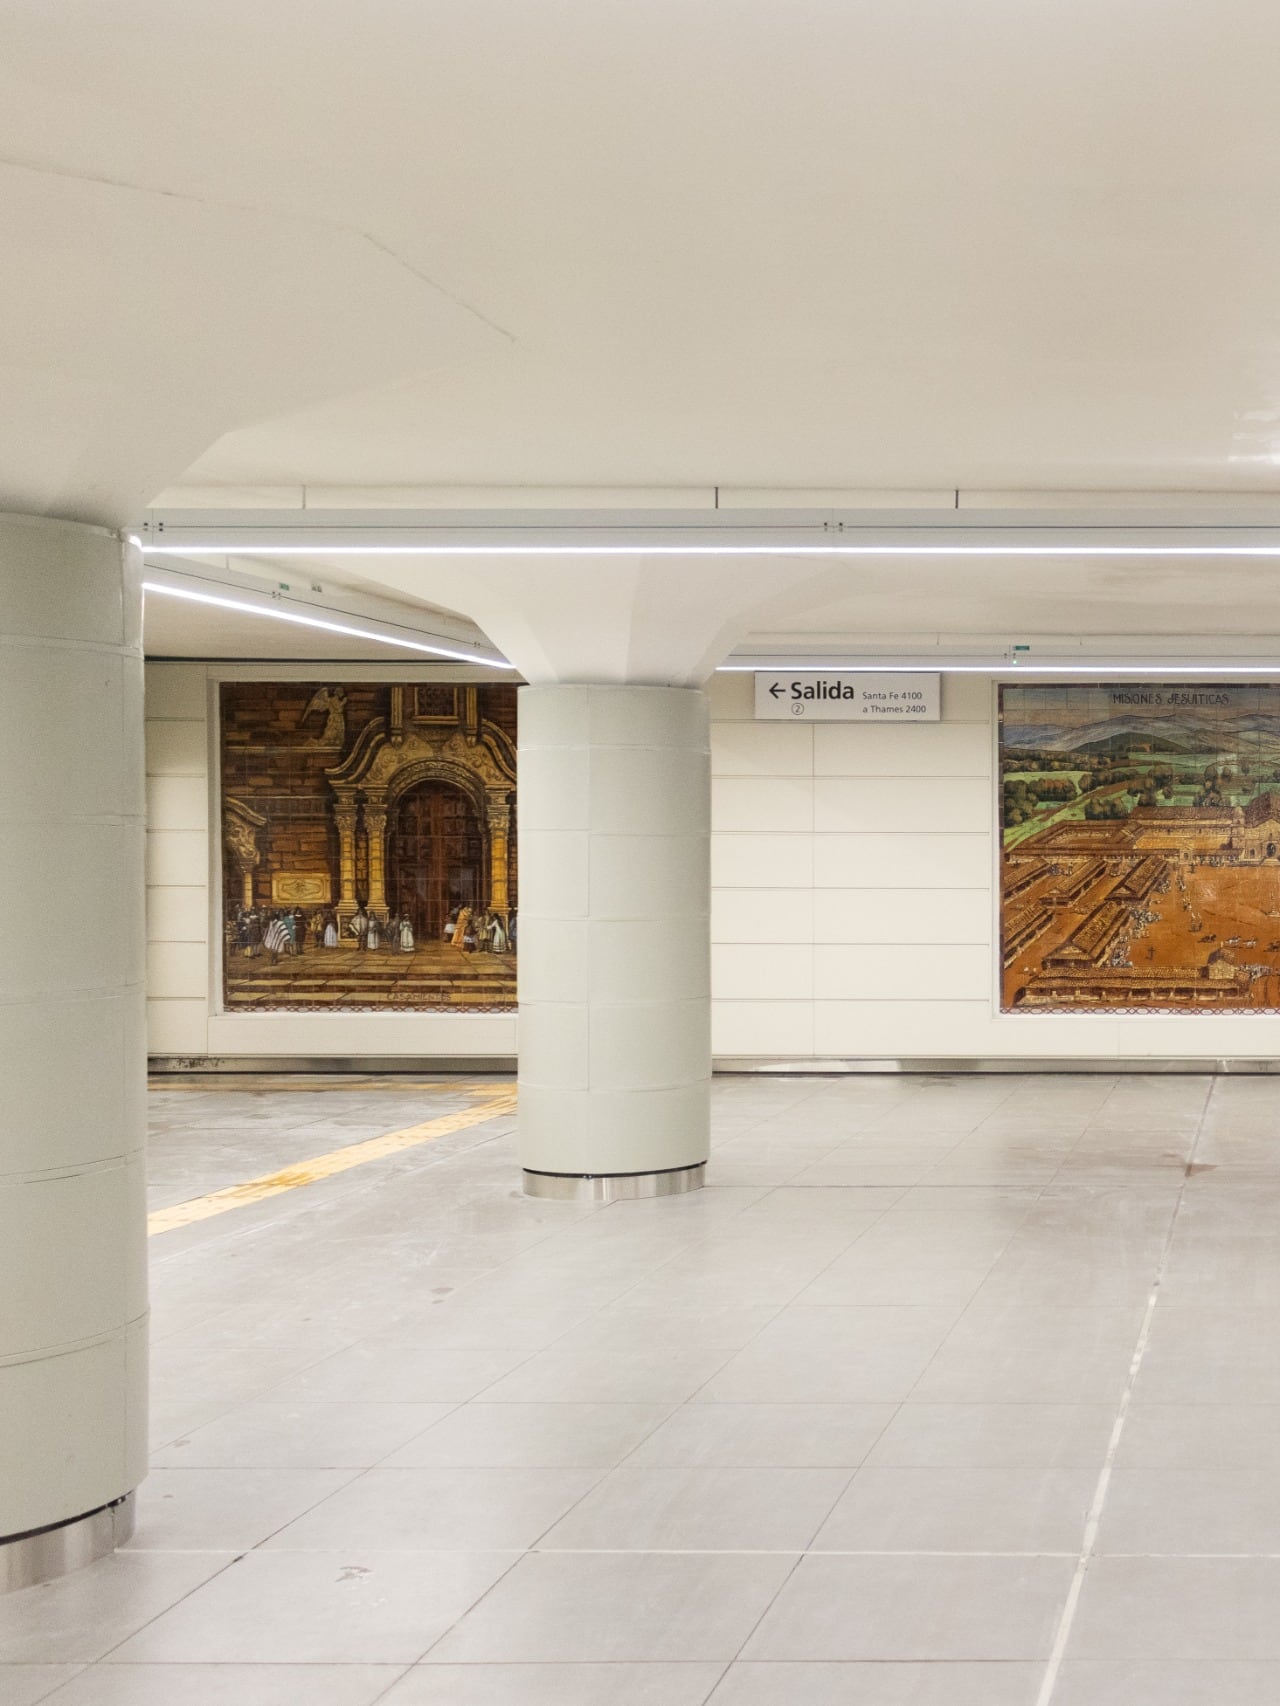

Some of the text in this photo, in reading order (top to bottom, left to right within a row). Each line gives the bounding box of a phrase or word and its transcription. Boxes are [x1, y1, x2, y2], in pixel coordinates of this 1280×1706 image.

[791, 681, 854, 700] Salida
[862, 692, 922, 700] Santa Fe 4100
[871, 705, 903, 713] Thames
[905, 705, 926, 713] 2400
